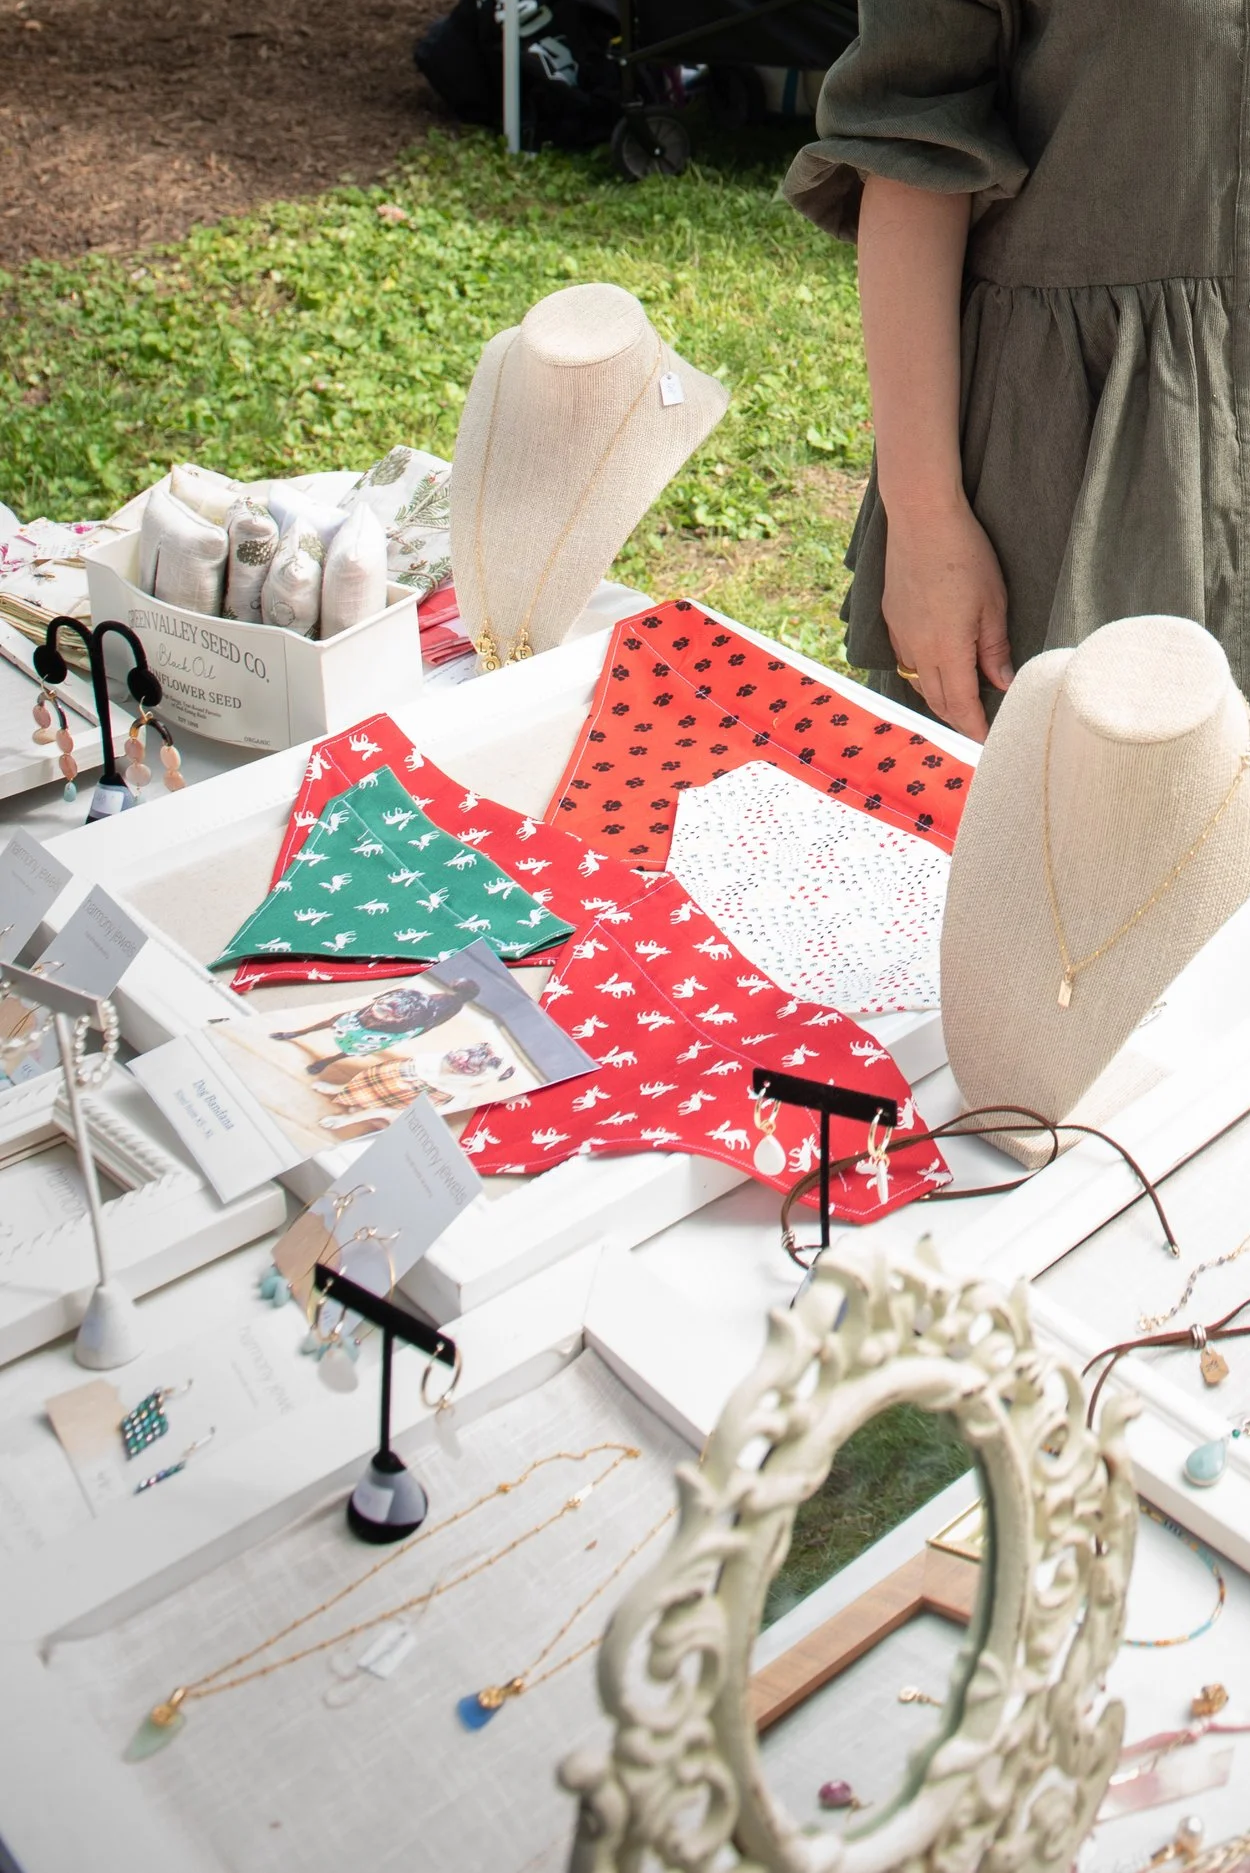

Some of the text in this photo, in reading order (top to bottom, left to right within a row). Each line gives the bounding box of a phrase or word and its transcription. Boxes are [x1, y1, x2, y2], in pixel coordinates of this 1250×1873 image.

[151, 611, 200, 645] VALLEY
[201, 629, 241, 665] SEED
[244, 651, 271, 684] CO.
[157, 643, 216, 681] Black Oil
[209, 692, 242, 710] SEED
[192, 1079, 236, 1131] Dog Bandana
[404, 1108, 441, 1167] harmony
[434, 1159, 468, 1206] jewels
